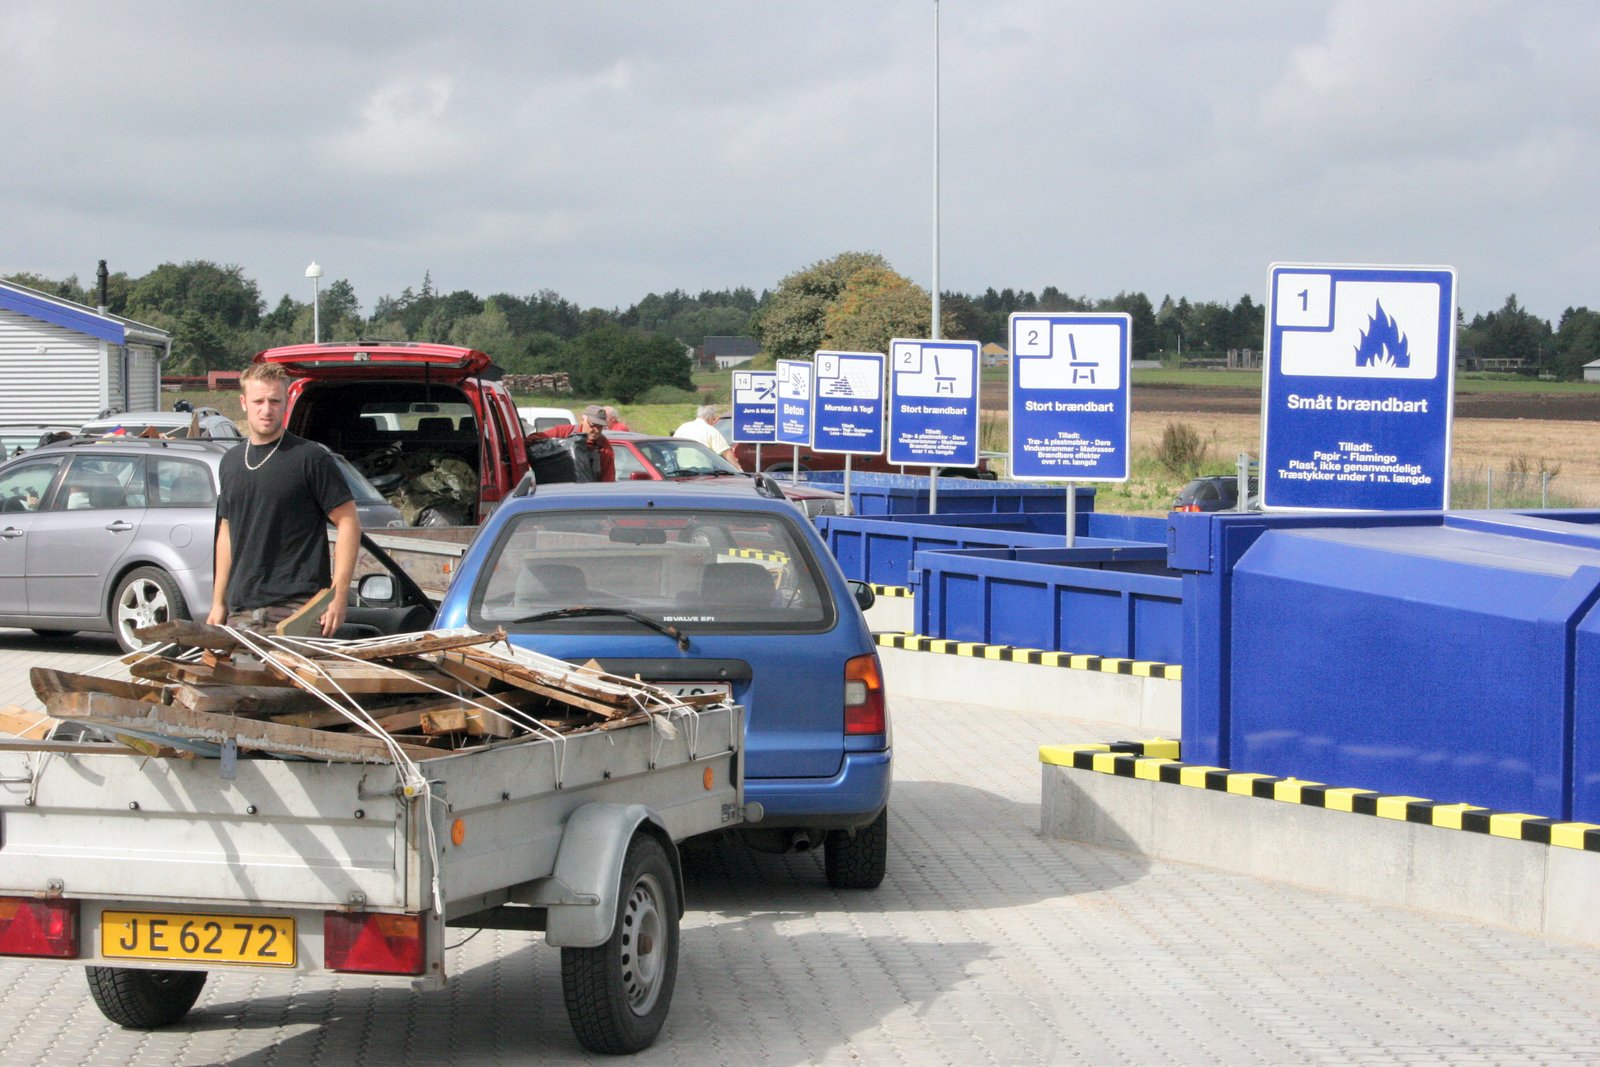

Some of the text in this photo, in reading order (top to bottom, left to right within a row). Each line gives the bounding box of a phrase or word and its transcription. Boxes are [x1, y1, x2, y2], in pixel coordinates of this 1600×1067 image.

[1297, 289, 1308, 311] 1
[1027, 330, 1038, 345] 2
[903, 352, 912, 364] 2
[825, 362, 832, 371] 9
[824, 404, 852, 412] Mursten
[859, 406, 874, 414] Tegl
[900, 404, 968, 415] Stort brændbart
[1025, 400, 1114, 412] Stort brændbart
[1287, 394, 1428, 413] Småt brændbart
[784, 404, 804, 416] Beton
[1338, 442, 1372, 452] Tilladt:
[1314, 451, 1340, 461] Papir
[1350, 452, 1397, 464] Flamingo
[1289, 460, 1422, 476] Plast, ikke genanvendeligt
[1278, 470, 1432, 486] Træstykker under 1 m. længde
